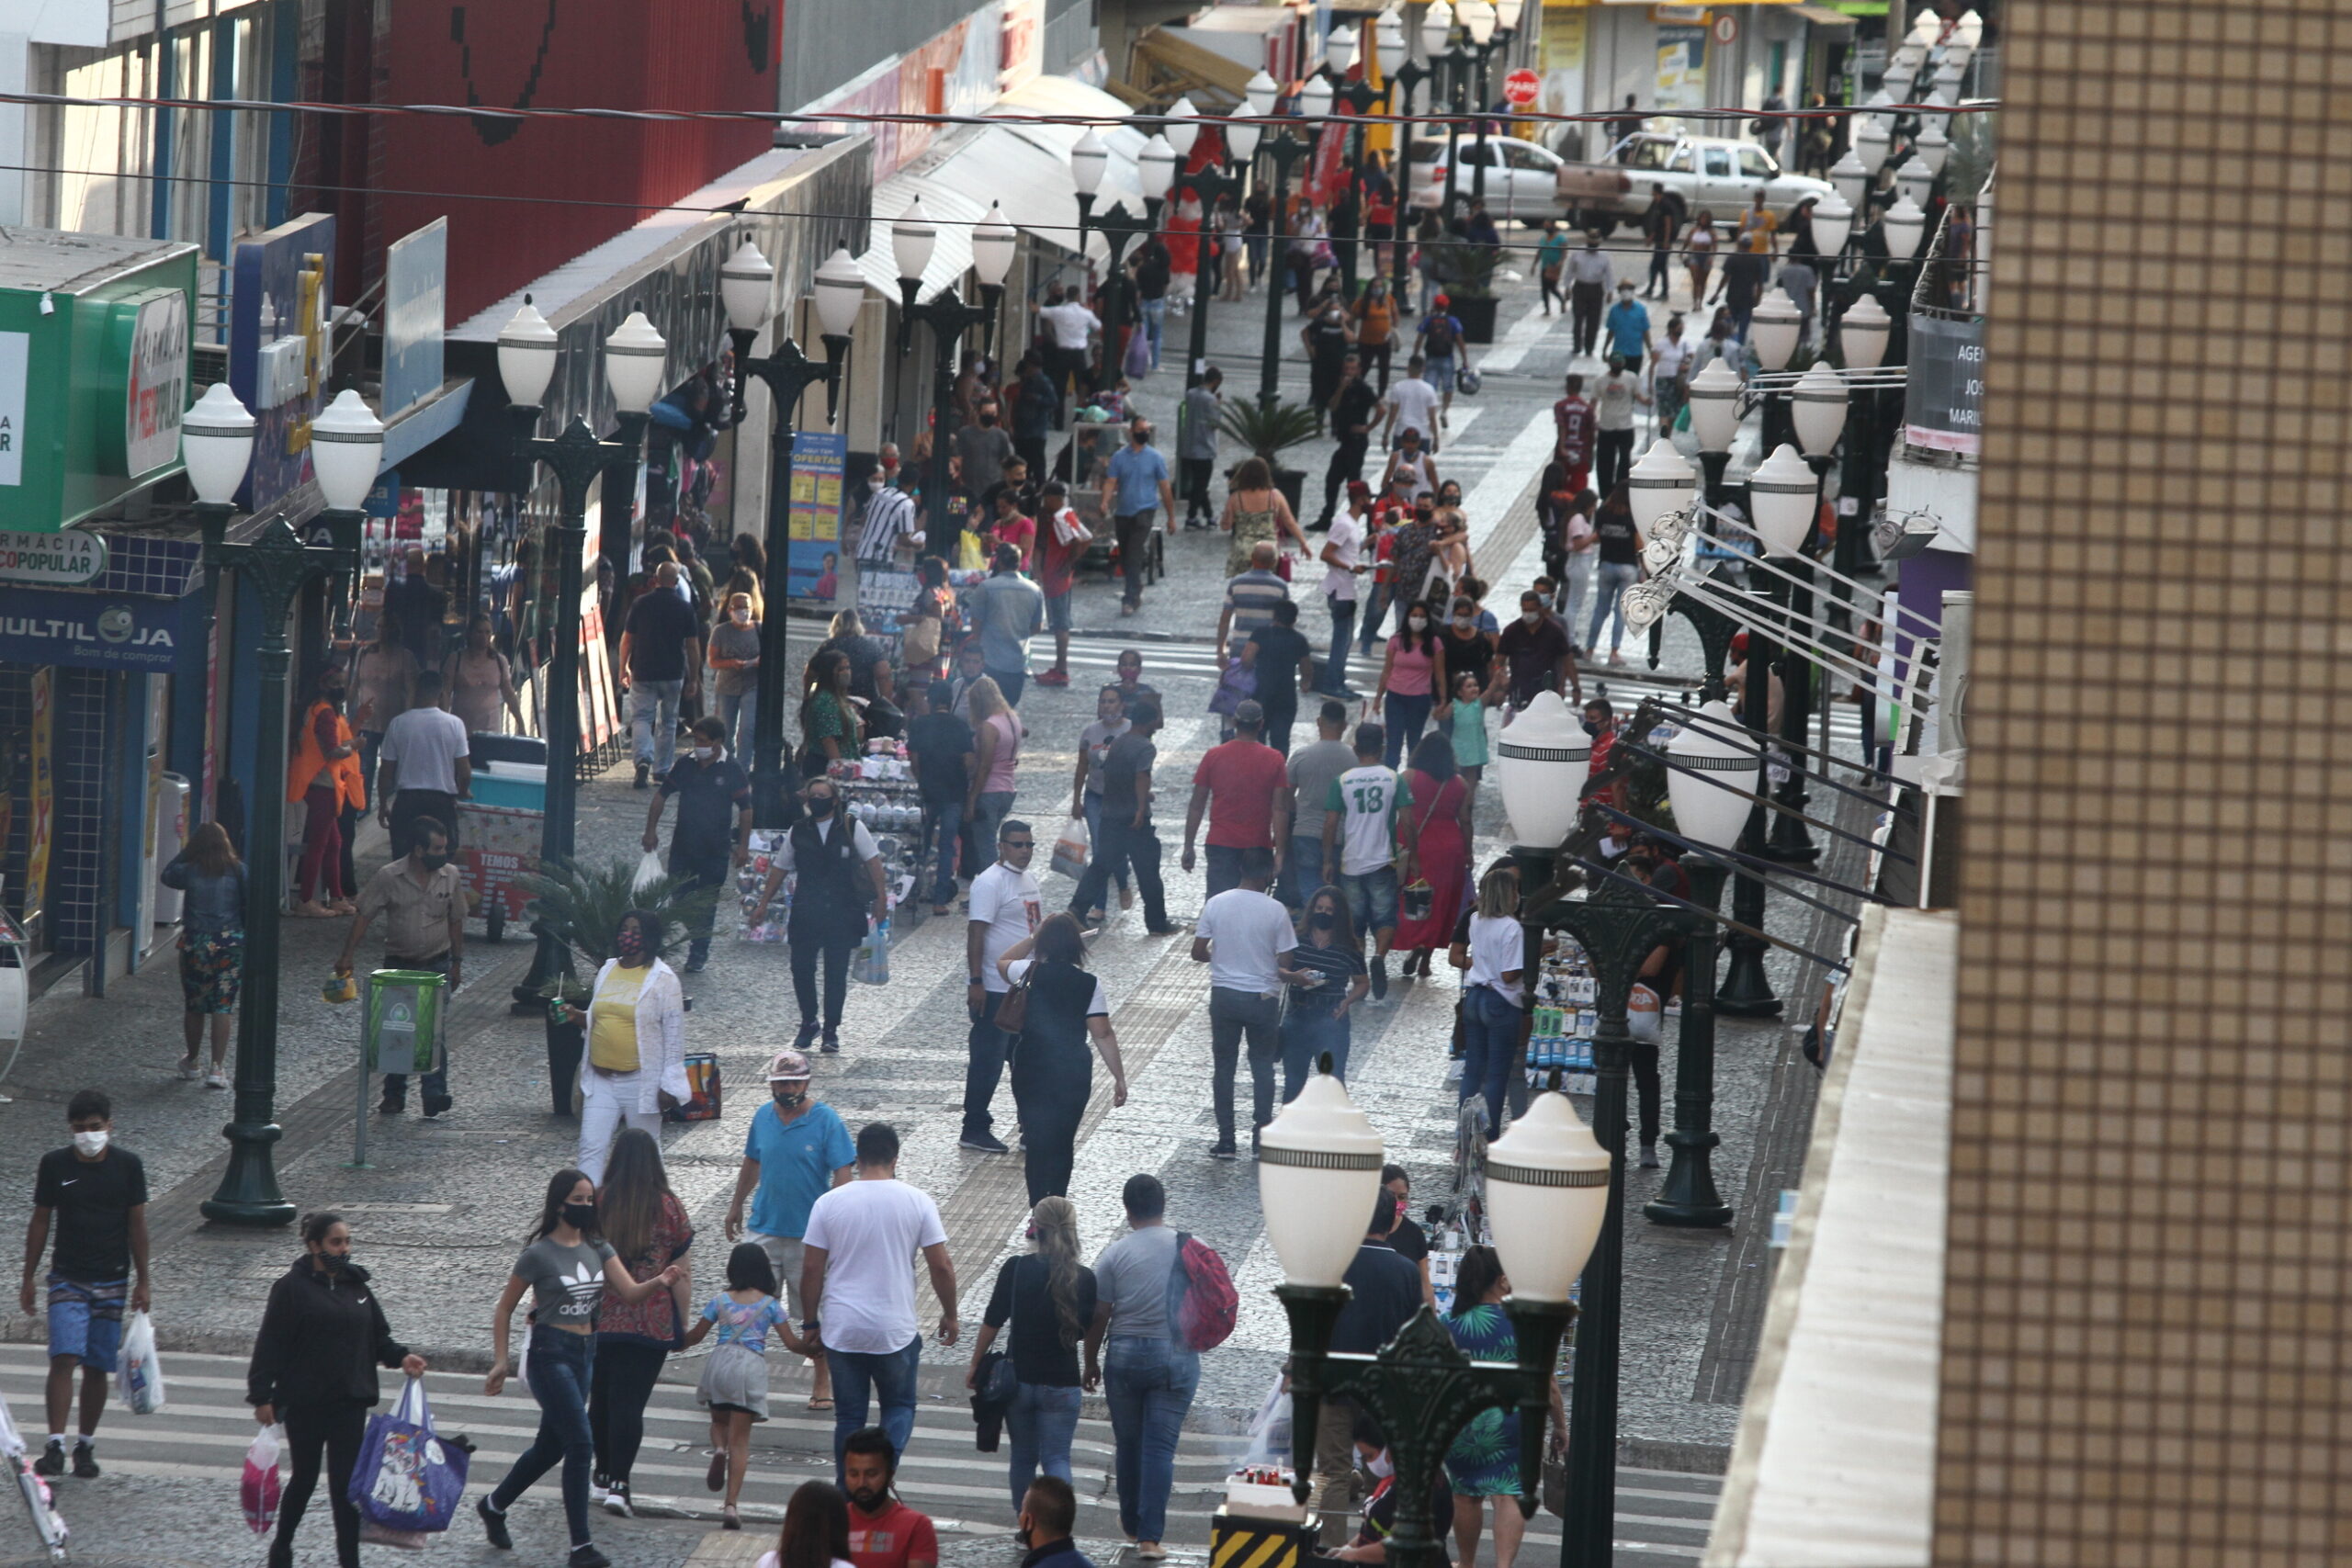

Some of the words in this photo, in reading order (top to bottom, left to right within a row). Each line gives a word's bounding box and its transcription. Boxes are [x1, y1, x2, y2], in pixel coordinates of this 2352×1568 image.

[1506, 81, 1539, 92] PARE
[793, 454, 842, 465] OFERTAS
[74, 645, 100, 656] Bom
[104, 648, 119, 659] de
[121, 650, 174, 663] comprar
[1353, 785, 1384, 814] 18
[481, 852, 520, 870] TEMOS
